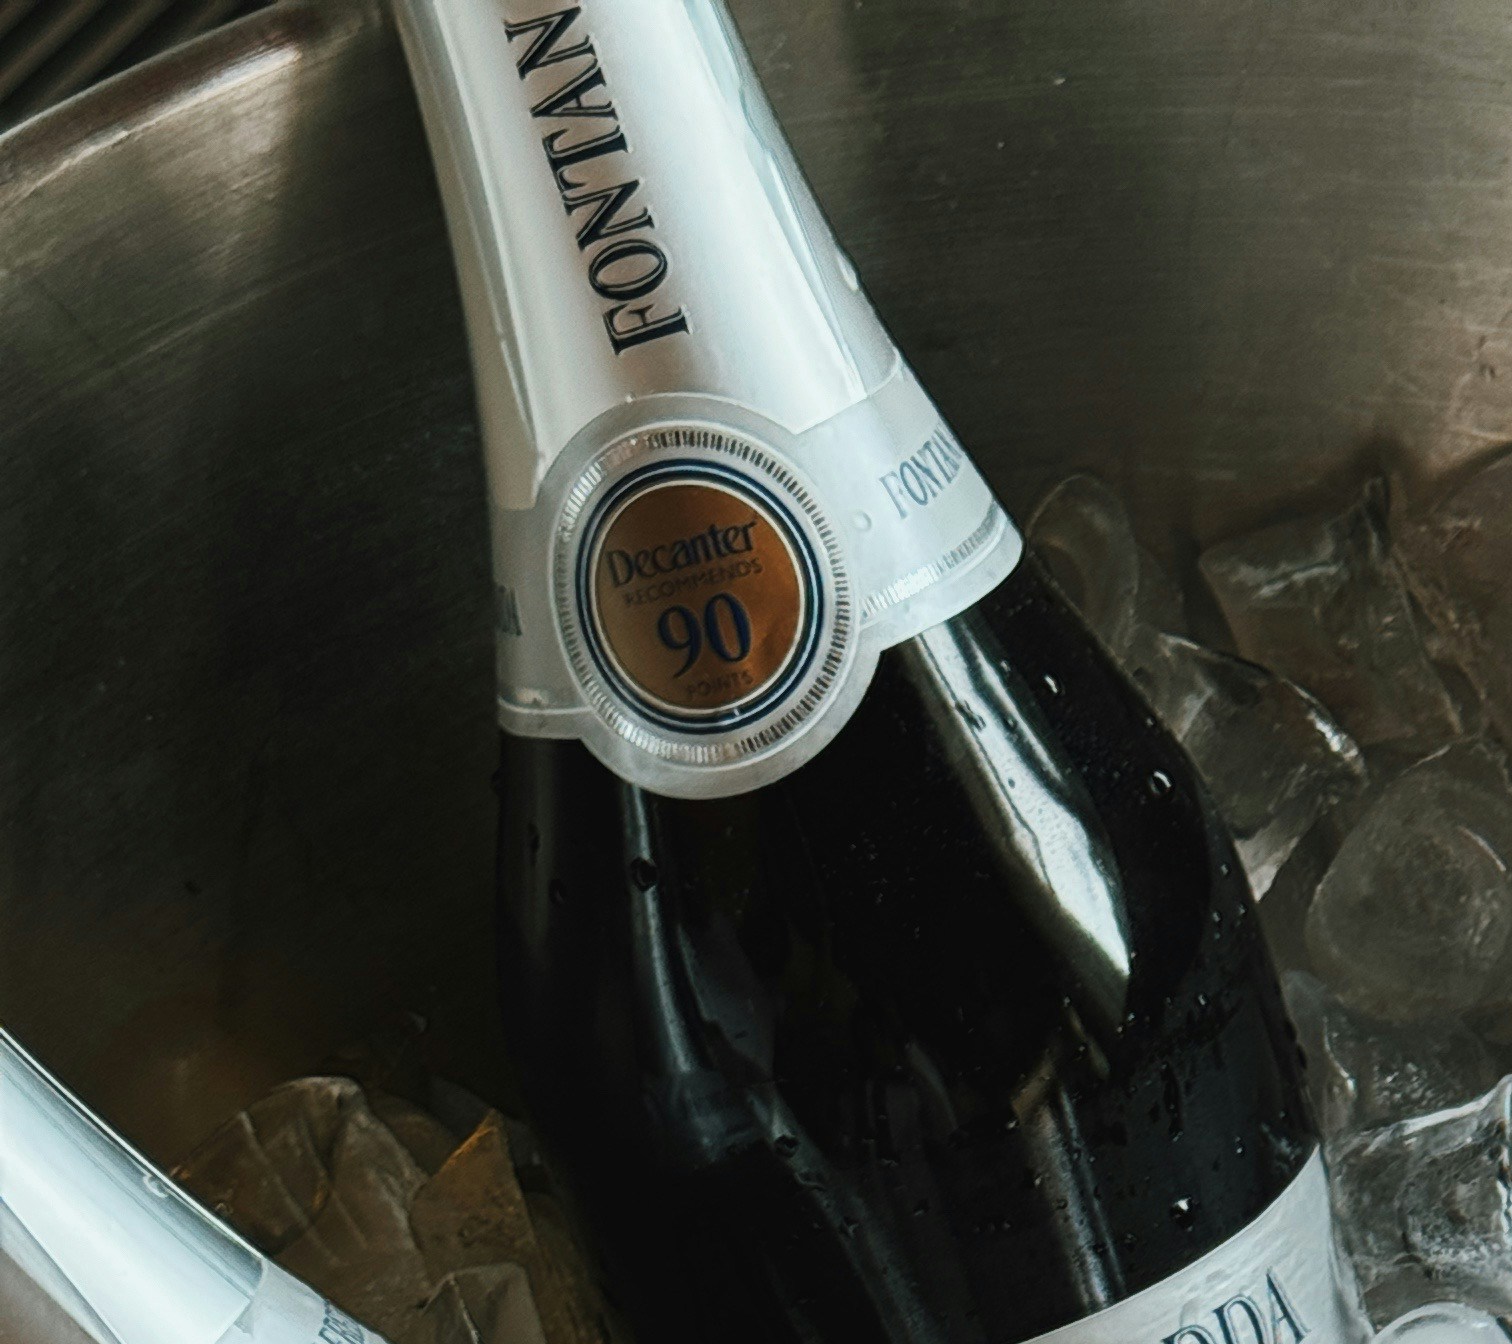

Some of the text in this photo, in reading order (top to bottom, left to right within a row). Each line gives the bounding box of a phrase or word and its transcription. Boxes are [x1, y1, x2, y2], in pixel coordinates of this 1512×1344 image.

[503, 5, 693, 355] FONTAN
[606, 518, 757, 588] Decanter
[657, 592, 751, 679] 90
